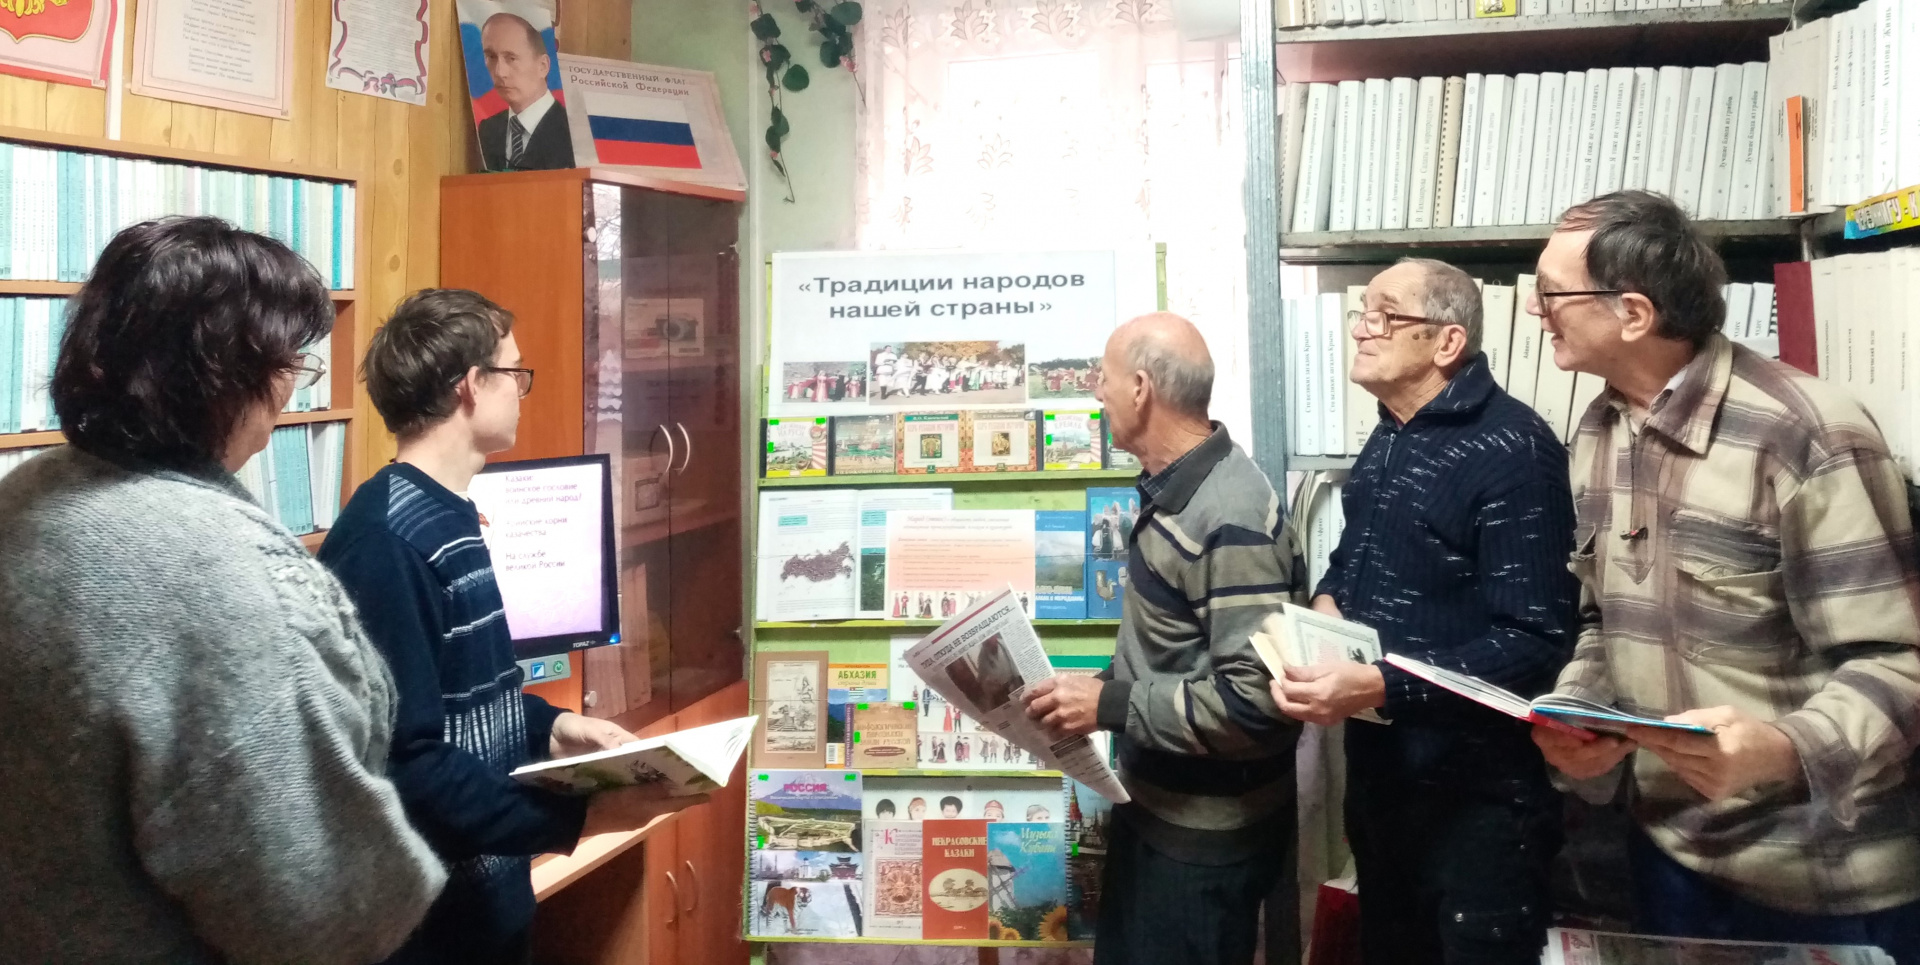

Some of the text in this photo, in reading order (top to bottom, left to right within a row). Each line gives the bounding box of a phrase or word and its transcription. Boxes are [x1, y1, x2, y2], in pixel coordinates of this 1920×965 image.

[569, 66, 659, 82] ГОСУДАРСТВЕННЫЙ
[571, 75, 689, 95] Российской Федерации
[798, 271, 1085, 298] «Традиции народов
[829, 299, 1052, 320] нашей страны»
[838, 671, 877, 679] АБХАЗИЯ
[784, 784, 827, 792] РОССИЯ
[932, 837, 987, 845] НЕКРАСОВСКИЕ
[944, 849, 974, 857] КАЗАКИ
